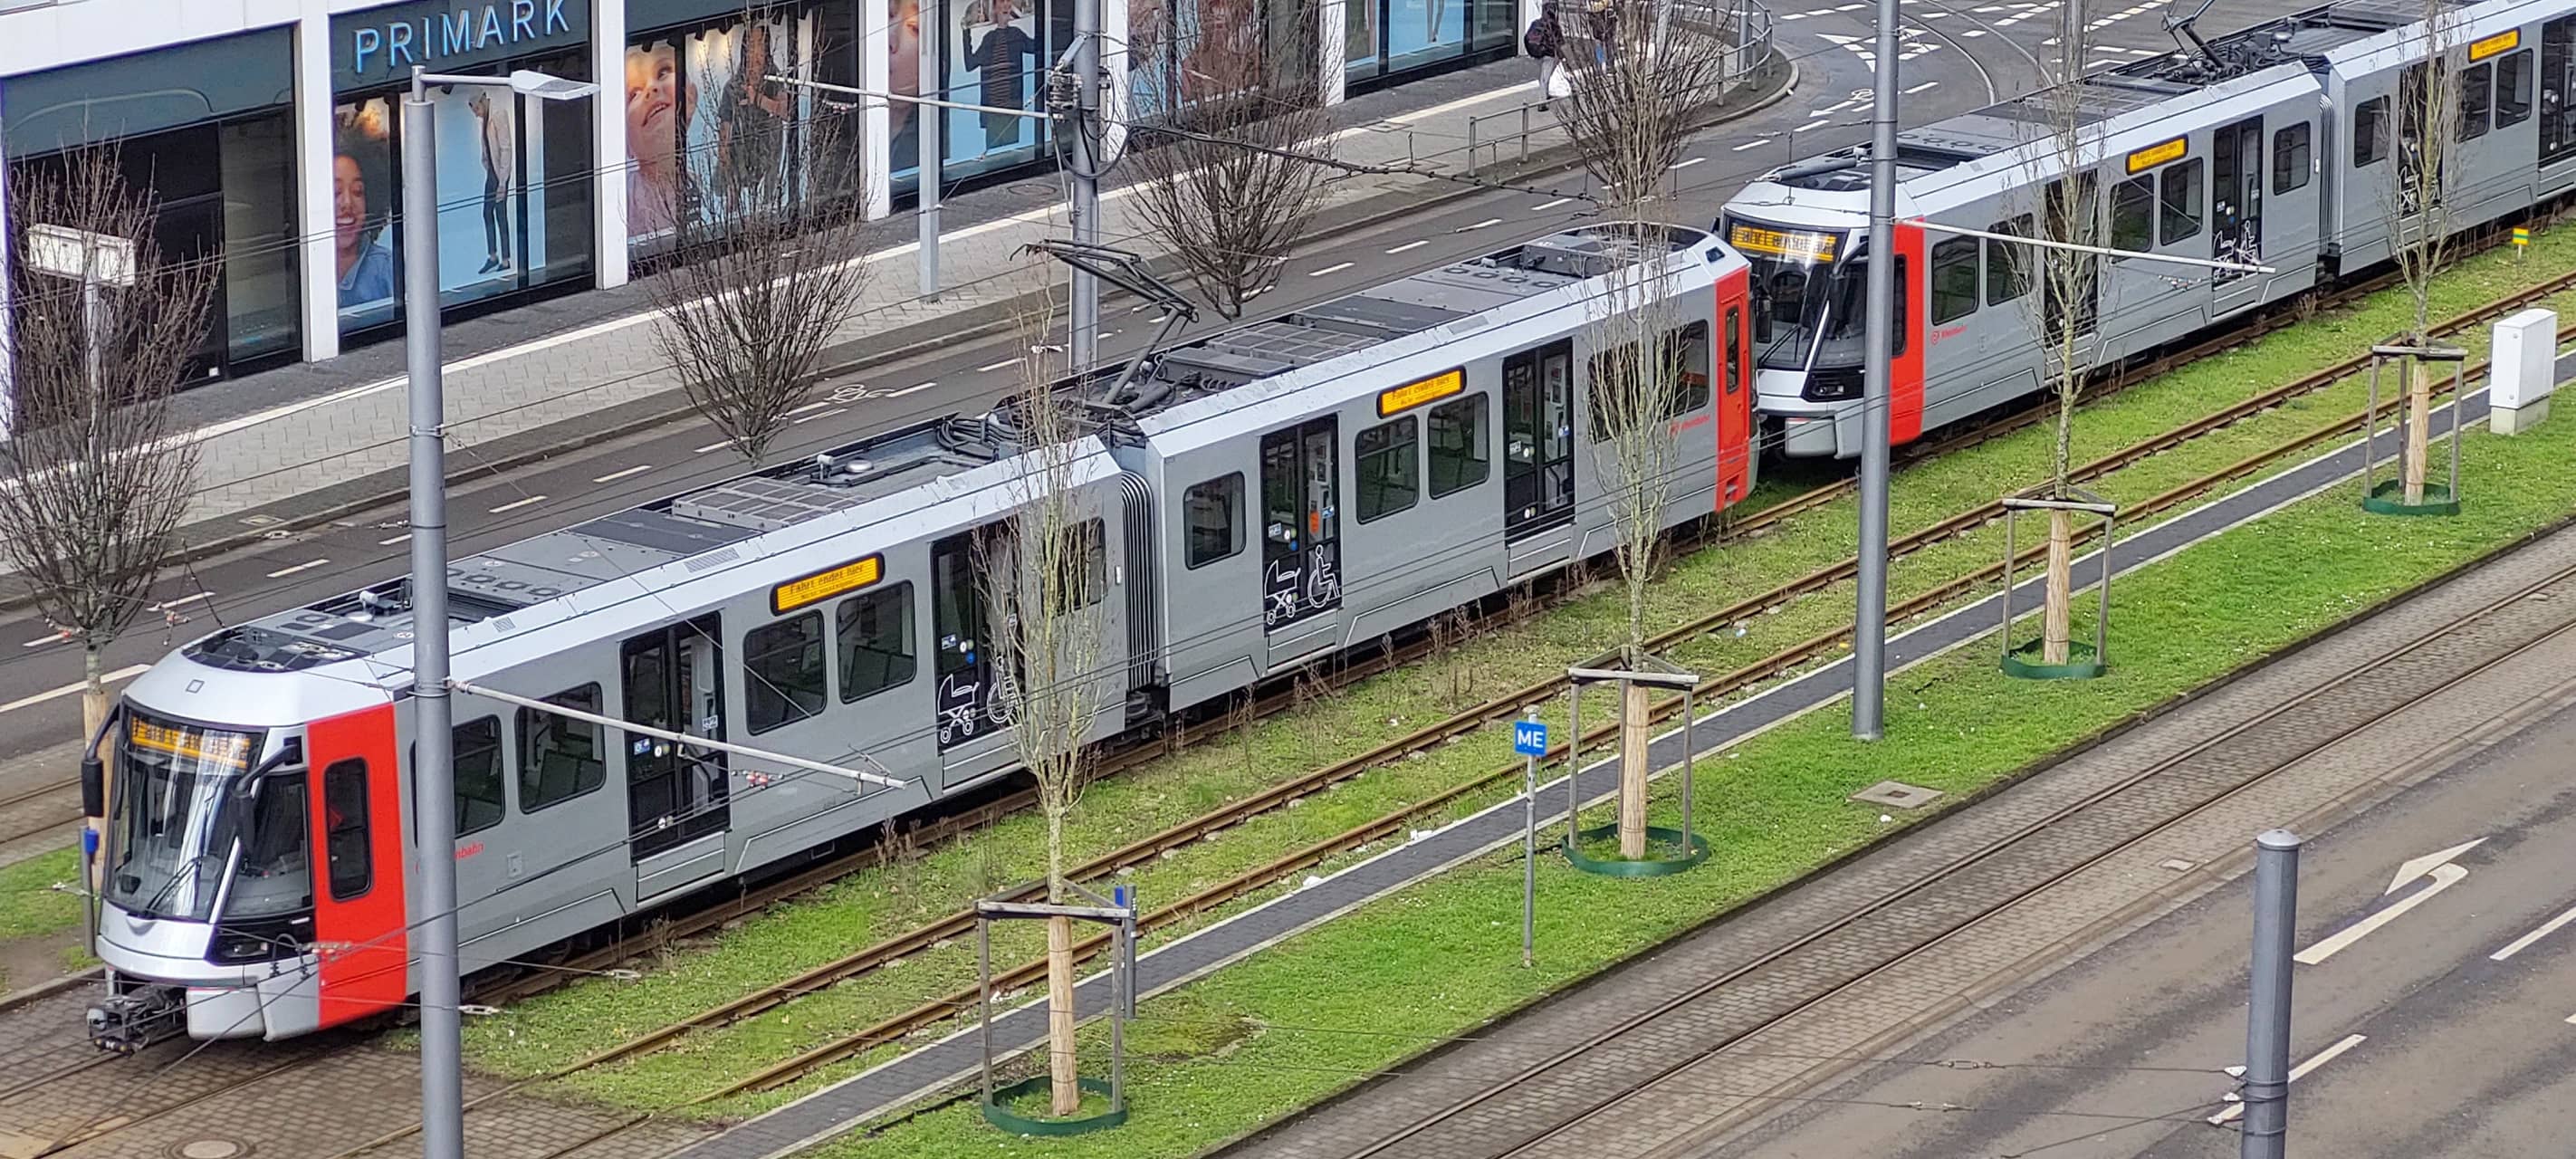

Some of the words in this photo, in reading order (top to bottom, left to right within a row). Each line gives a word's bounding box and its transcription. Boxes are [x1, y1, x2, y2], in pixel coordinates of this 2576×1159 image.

[354, 0, 570, 73] PRIMARK
[790, 580, 814, 594] Fahrt
[819, 571, 843, 585] endet
[847, 564, 864, 576] hier
[1518, 729, 1544, 748] ME
